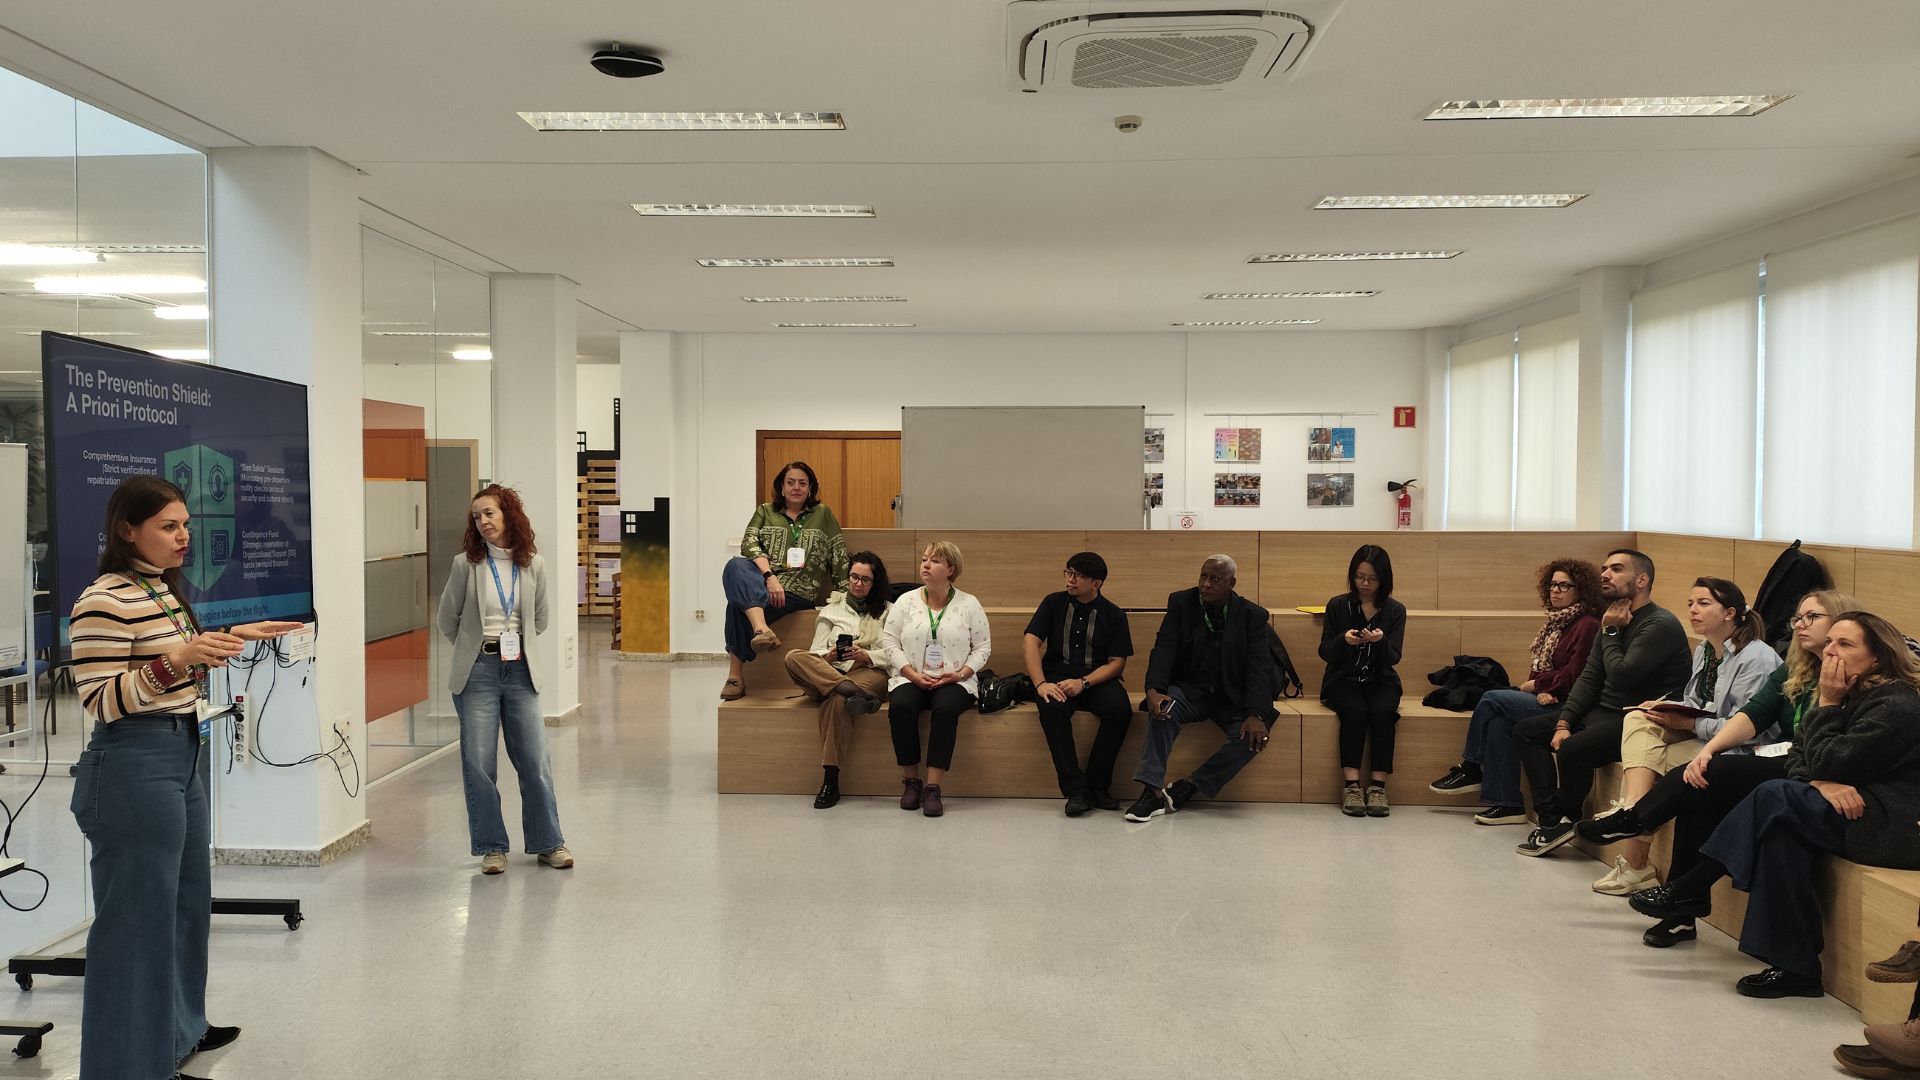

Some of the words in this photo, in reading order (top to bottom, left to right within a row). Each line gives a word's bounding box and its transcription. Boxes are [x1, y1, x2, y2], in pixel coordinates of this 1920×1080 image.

[65, 364, 93, 388] The
[98, 370, 168, 399] Prevention
[172, 383, 211, 406] Shield:
[66, 391, 78, 413] A
[82, 393, 119, 418] Priori
[123, 400, 177, 425] Protocol
[83, 449, 129, 462] Comprehensive
[130, 453, 157, 464] Insurance
[120, 465, 151, 476] verification
[152, 467, 157, 476] of
[87, 475, 121, 486] repatriation
[242, 530, 268, 539] Contingency
[268, 530, 279, 538] Fund
[199, 610, 220, 622] begins
[222, 607, 242, 619] before
[243, 606, 252, 616] the
